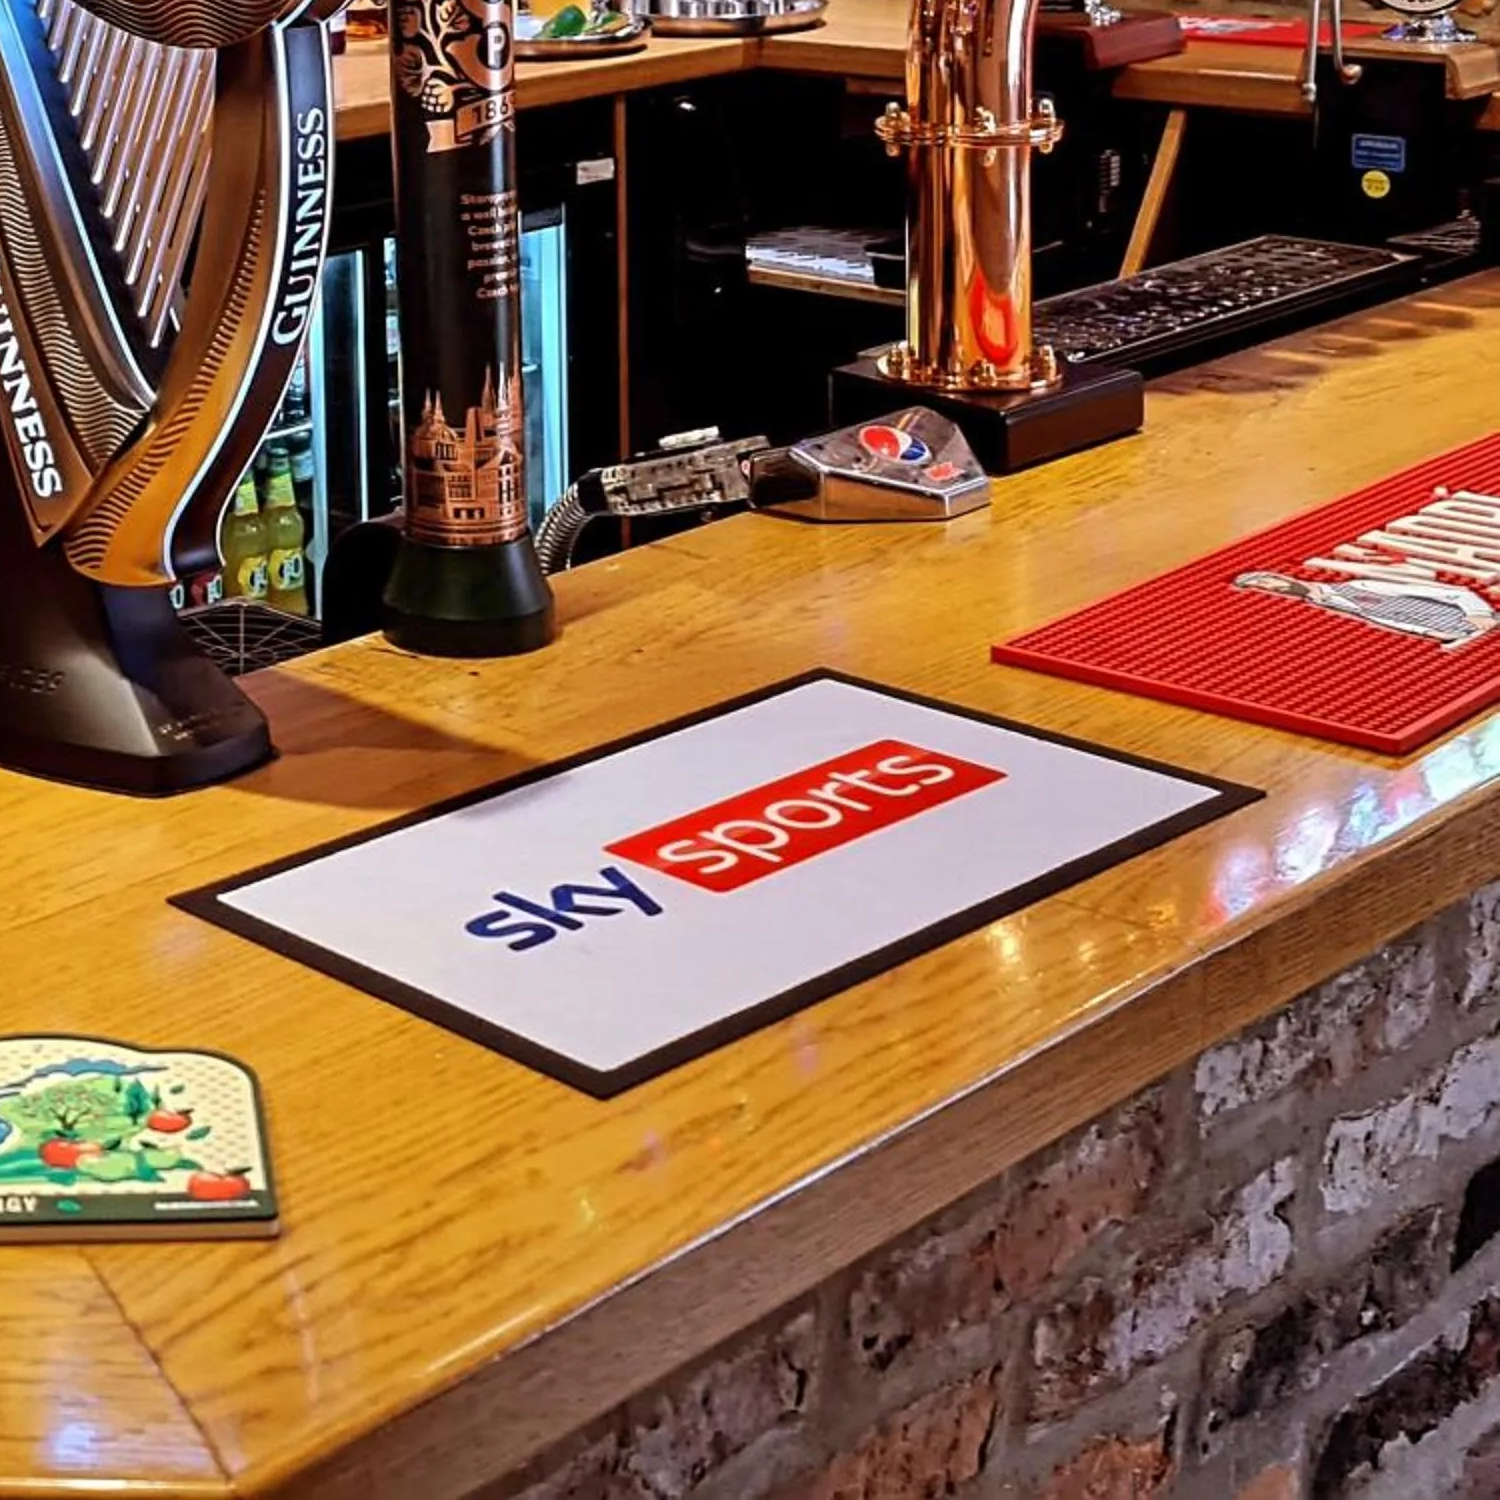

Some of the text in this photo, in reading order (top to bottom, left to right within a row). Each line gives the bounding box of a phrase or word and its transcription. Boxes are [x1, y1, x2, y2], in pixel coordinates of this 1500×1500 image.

[472, 100, 512, 128] 186
[271, 106, 326, 346] GUINNESS
[465, 754, 956, 952] sky sports
